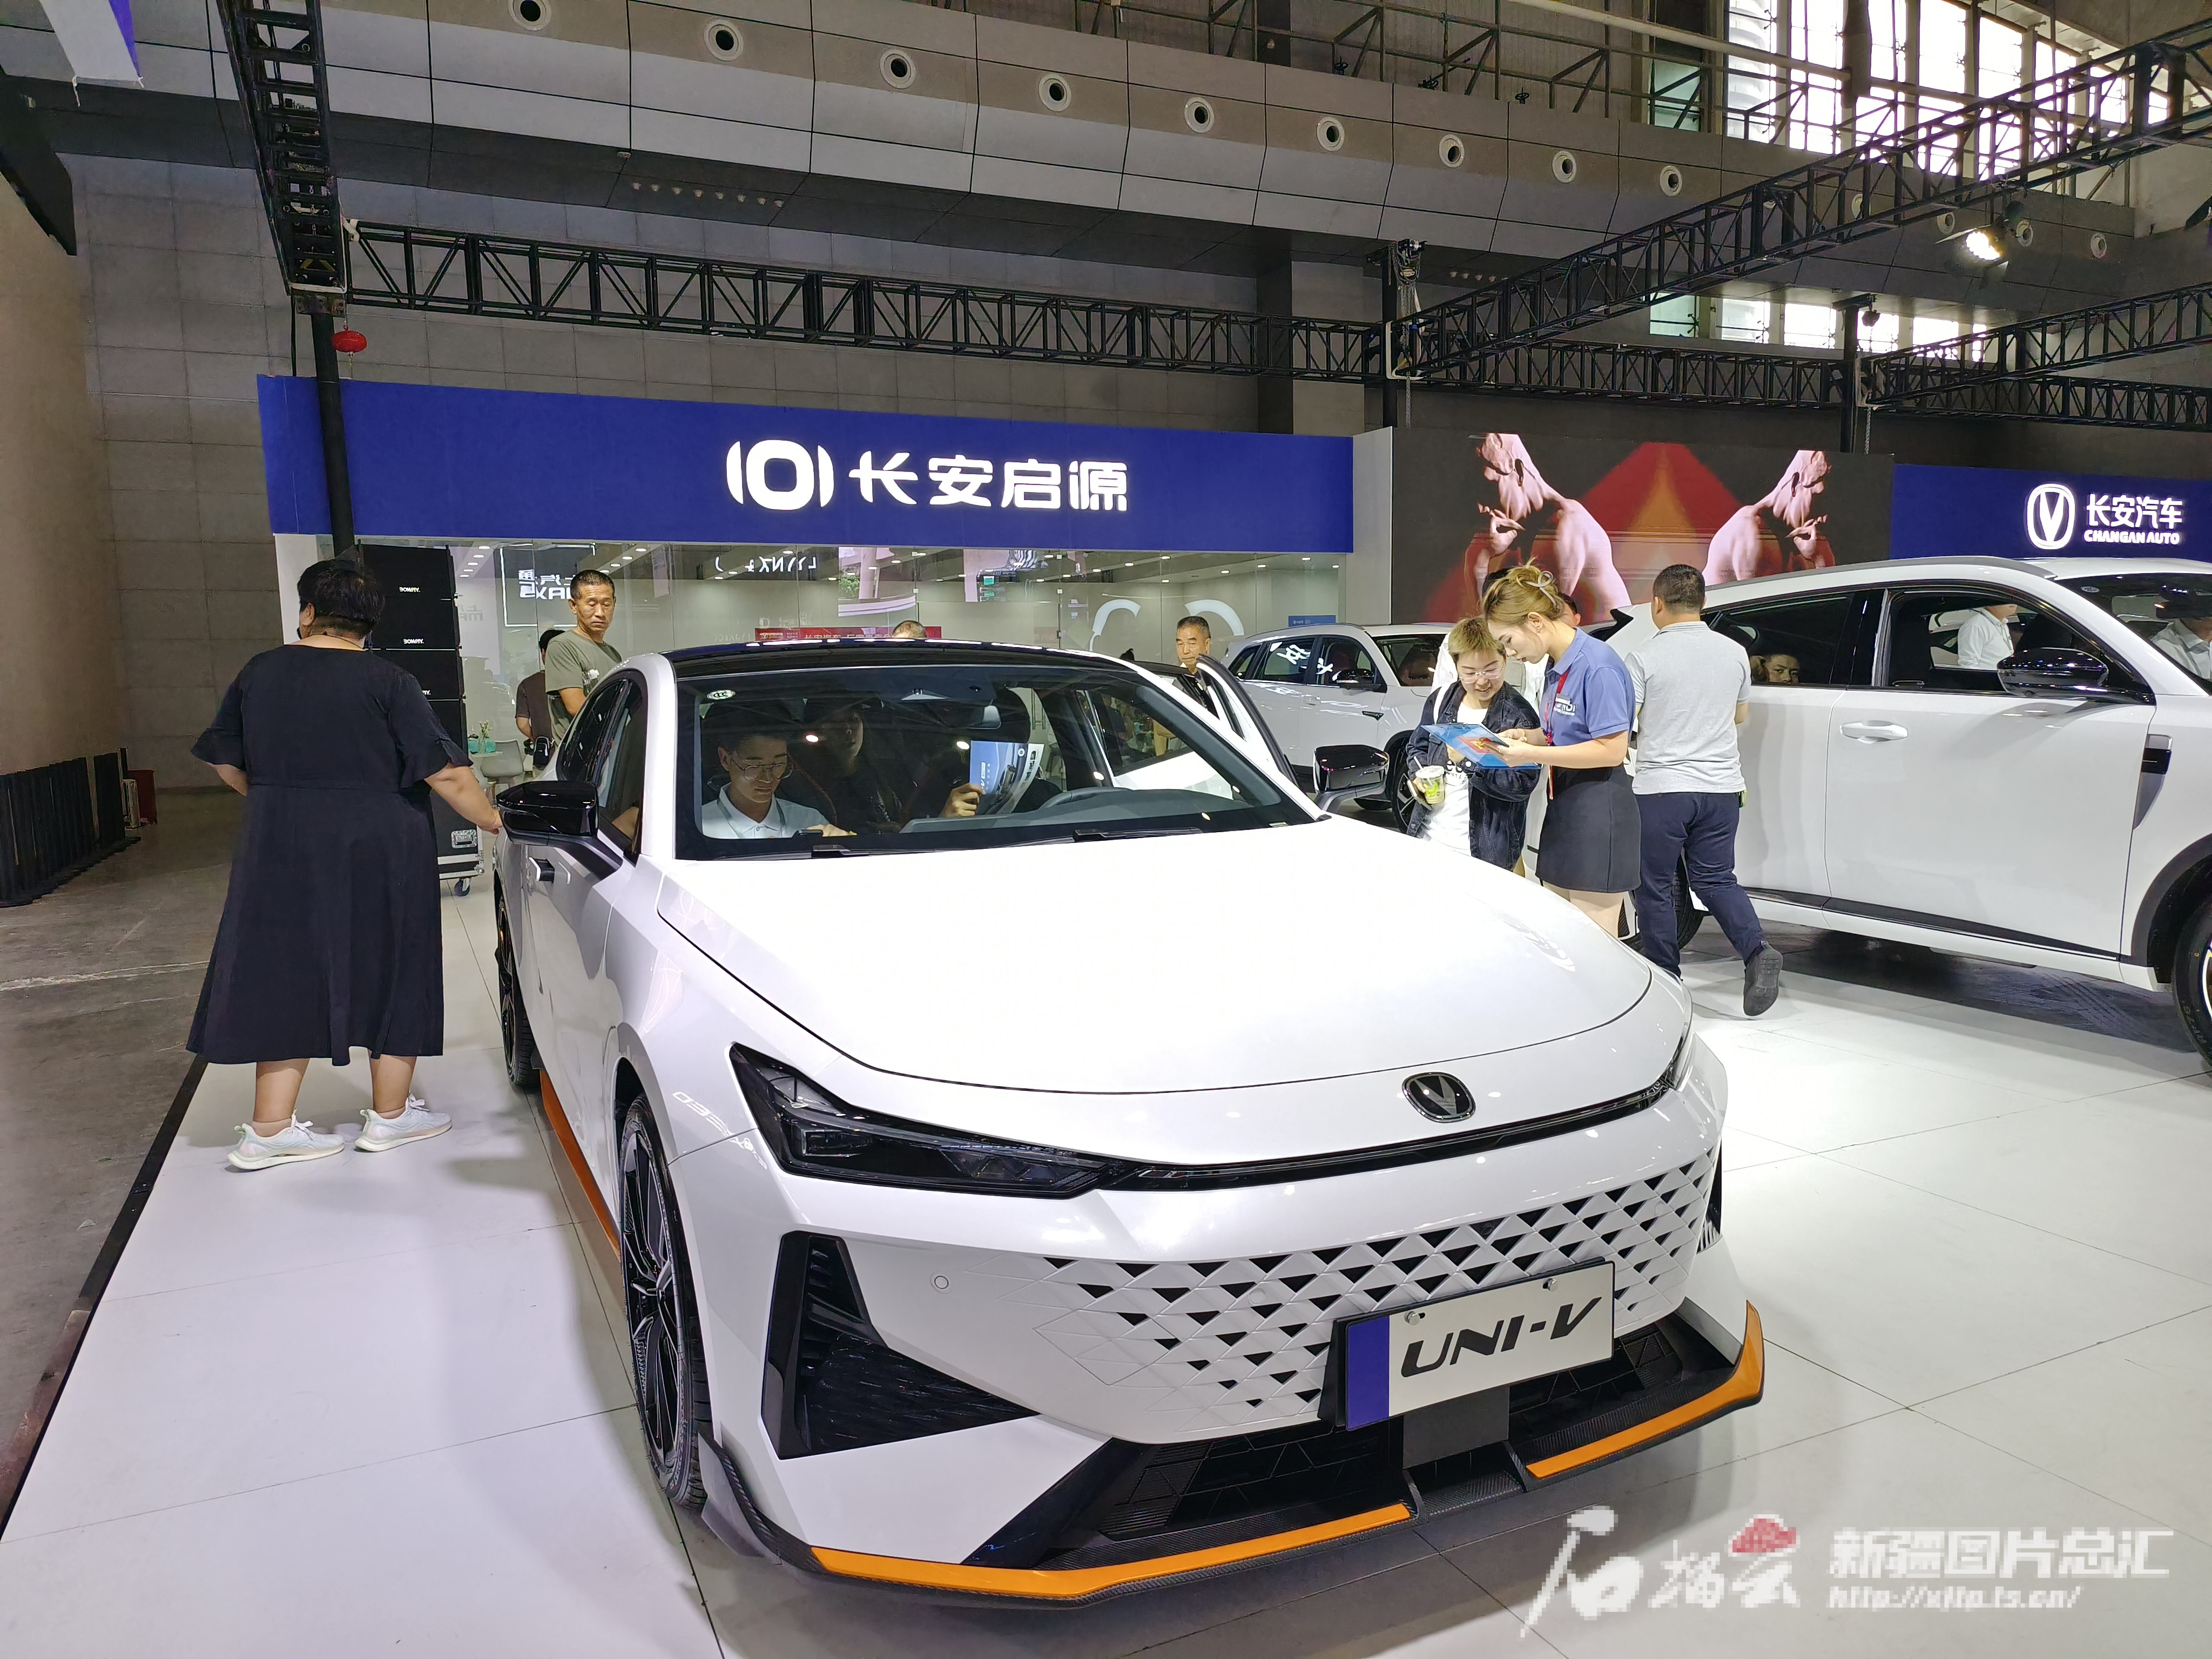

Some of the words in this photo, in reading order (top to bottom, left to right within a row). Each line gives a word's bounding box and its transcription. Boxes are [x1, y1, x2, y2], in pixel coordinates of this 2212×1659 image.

[849, 450, 1128, 511] 长安启源
[2086, 494, 2183, 529] 长安汽车
[2084, 529, 2146, 543] CHANGAN
[2146, 531, 2180, 545] AUTO
[1401, 1297, 1602, 1378] UNI-V
